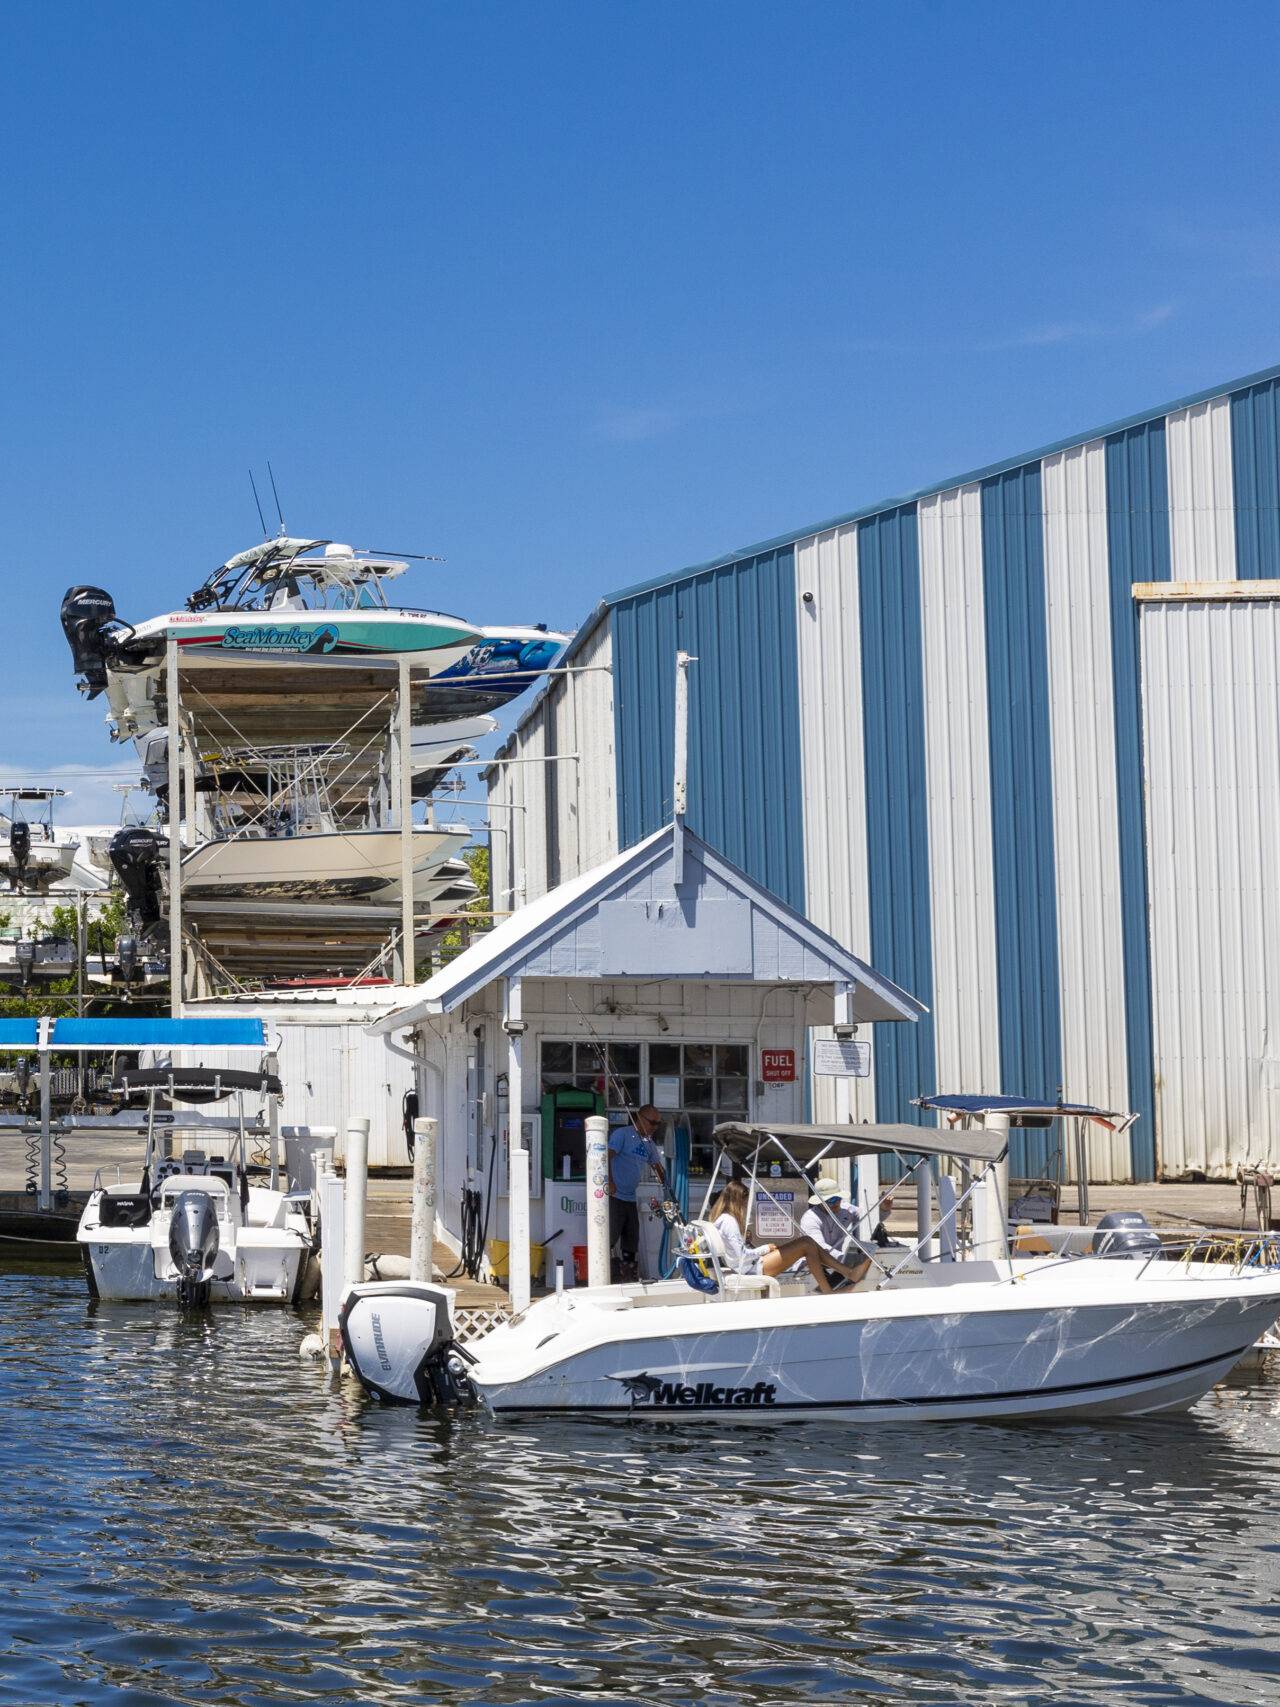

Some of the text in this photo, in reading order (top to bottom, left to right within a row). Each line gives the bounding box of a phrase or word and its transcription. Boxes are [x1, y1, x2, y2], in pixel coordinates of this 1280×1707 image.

[78, 599, 112, 607] MERCURY
[224, 626, 317, 650] SeaMonkey
[765, 1055, 793, 1067] FUEL
[757, 1192, 793, 1201] UNADED
[371, 1311, 392, 1371] EVINRUDE
[654, 1382, 777, 1404] Wellcraft
